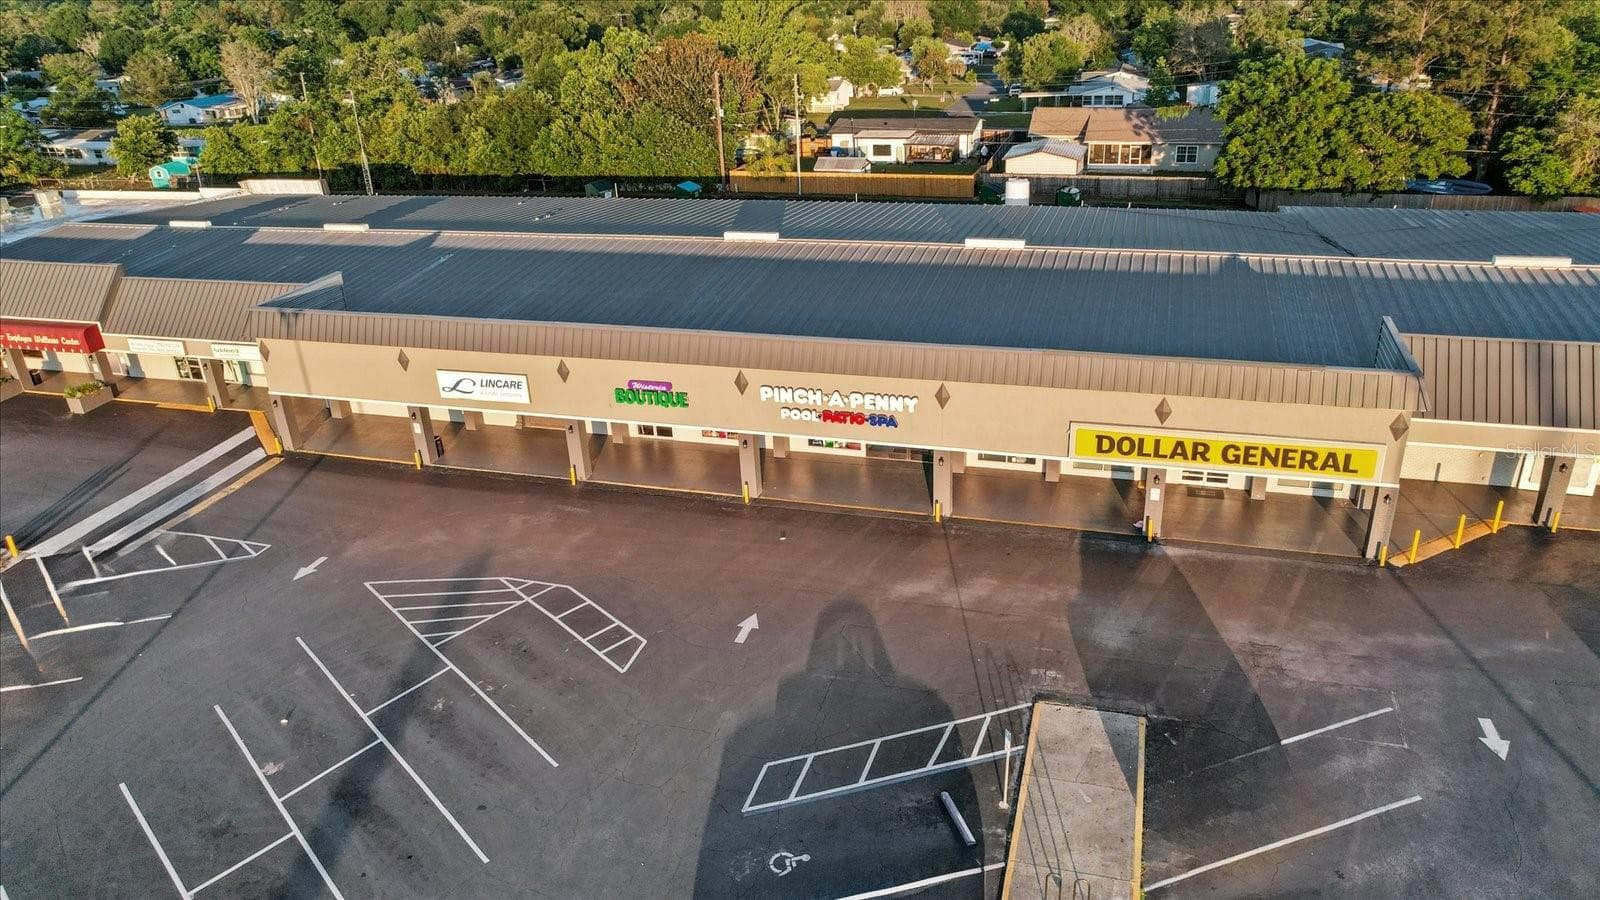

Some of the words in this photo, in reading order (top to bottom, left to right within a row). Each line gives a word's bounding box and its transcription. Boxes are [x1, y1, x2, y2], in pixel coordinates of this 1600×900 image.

[61, 337, 80, 346] Center
[480, 379, 523, 389] LINCARE
[614, 388, 689, 408] BOUTIQUE
[1095, 435, 1210, 462] DOLLAR
[1221, 444, 1359, 473] GENERAL
